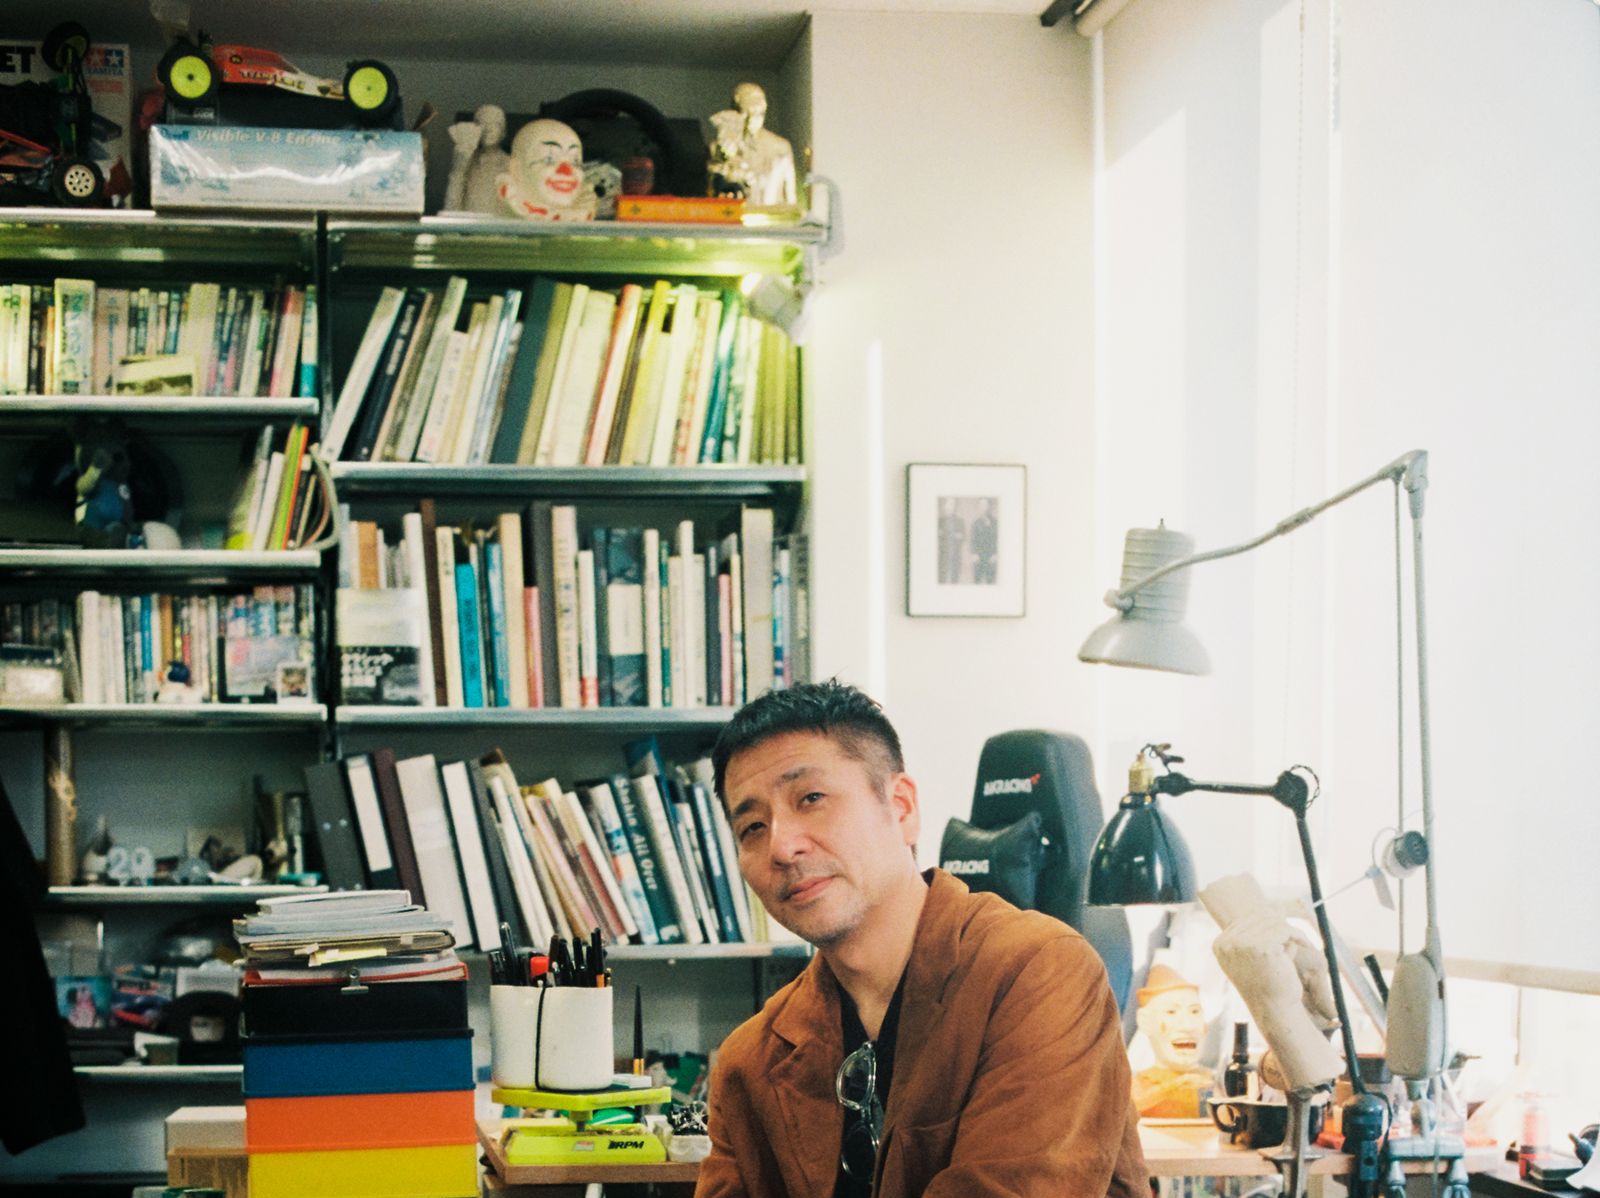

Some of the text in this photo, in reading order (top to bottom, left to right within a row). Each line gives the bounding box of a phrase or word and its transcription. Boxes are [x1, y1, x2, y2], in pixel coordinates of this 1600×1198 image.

[197, 129, 250, 143] Visible
[256, 131, 281, 143] V-8
[285, 132, 341, 148] Engine
[614, 776, 658, 891] Shake All Over
[614, 1140, 644, 1150] RPM
